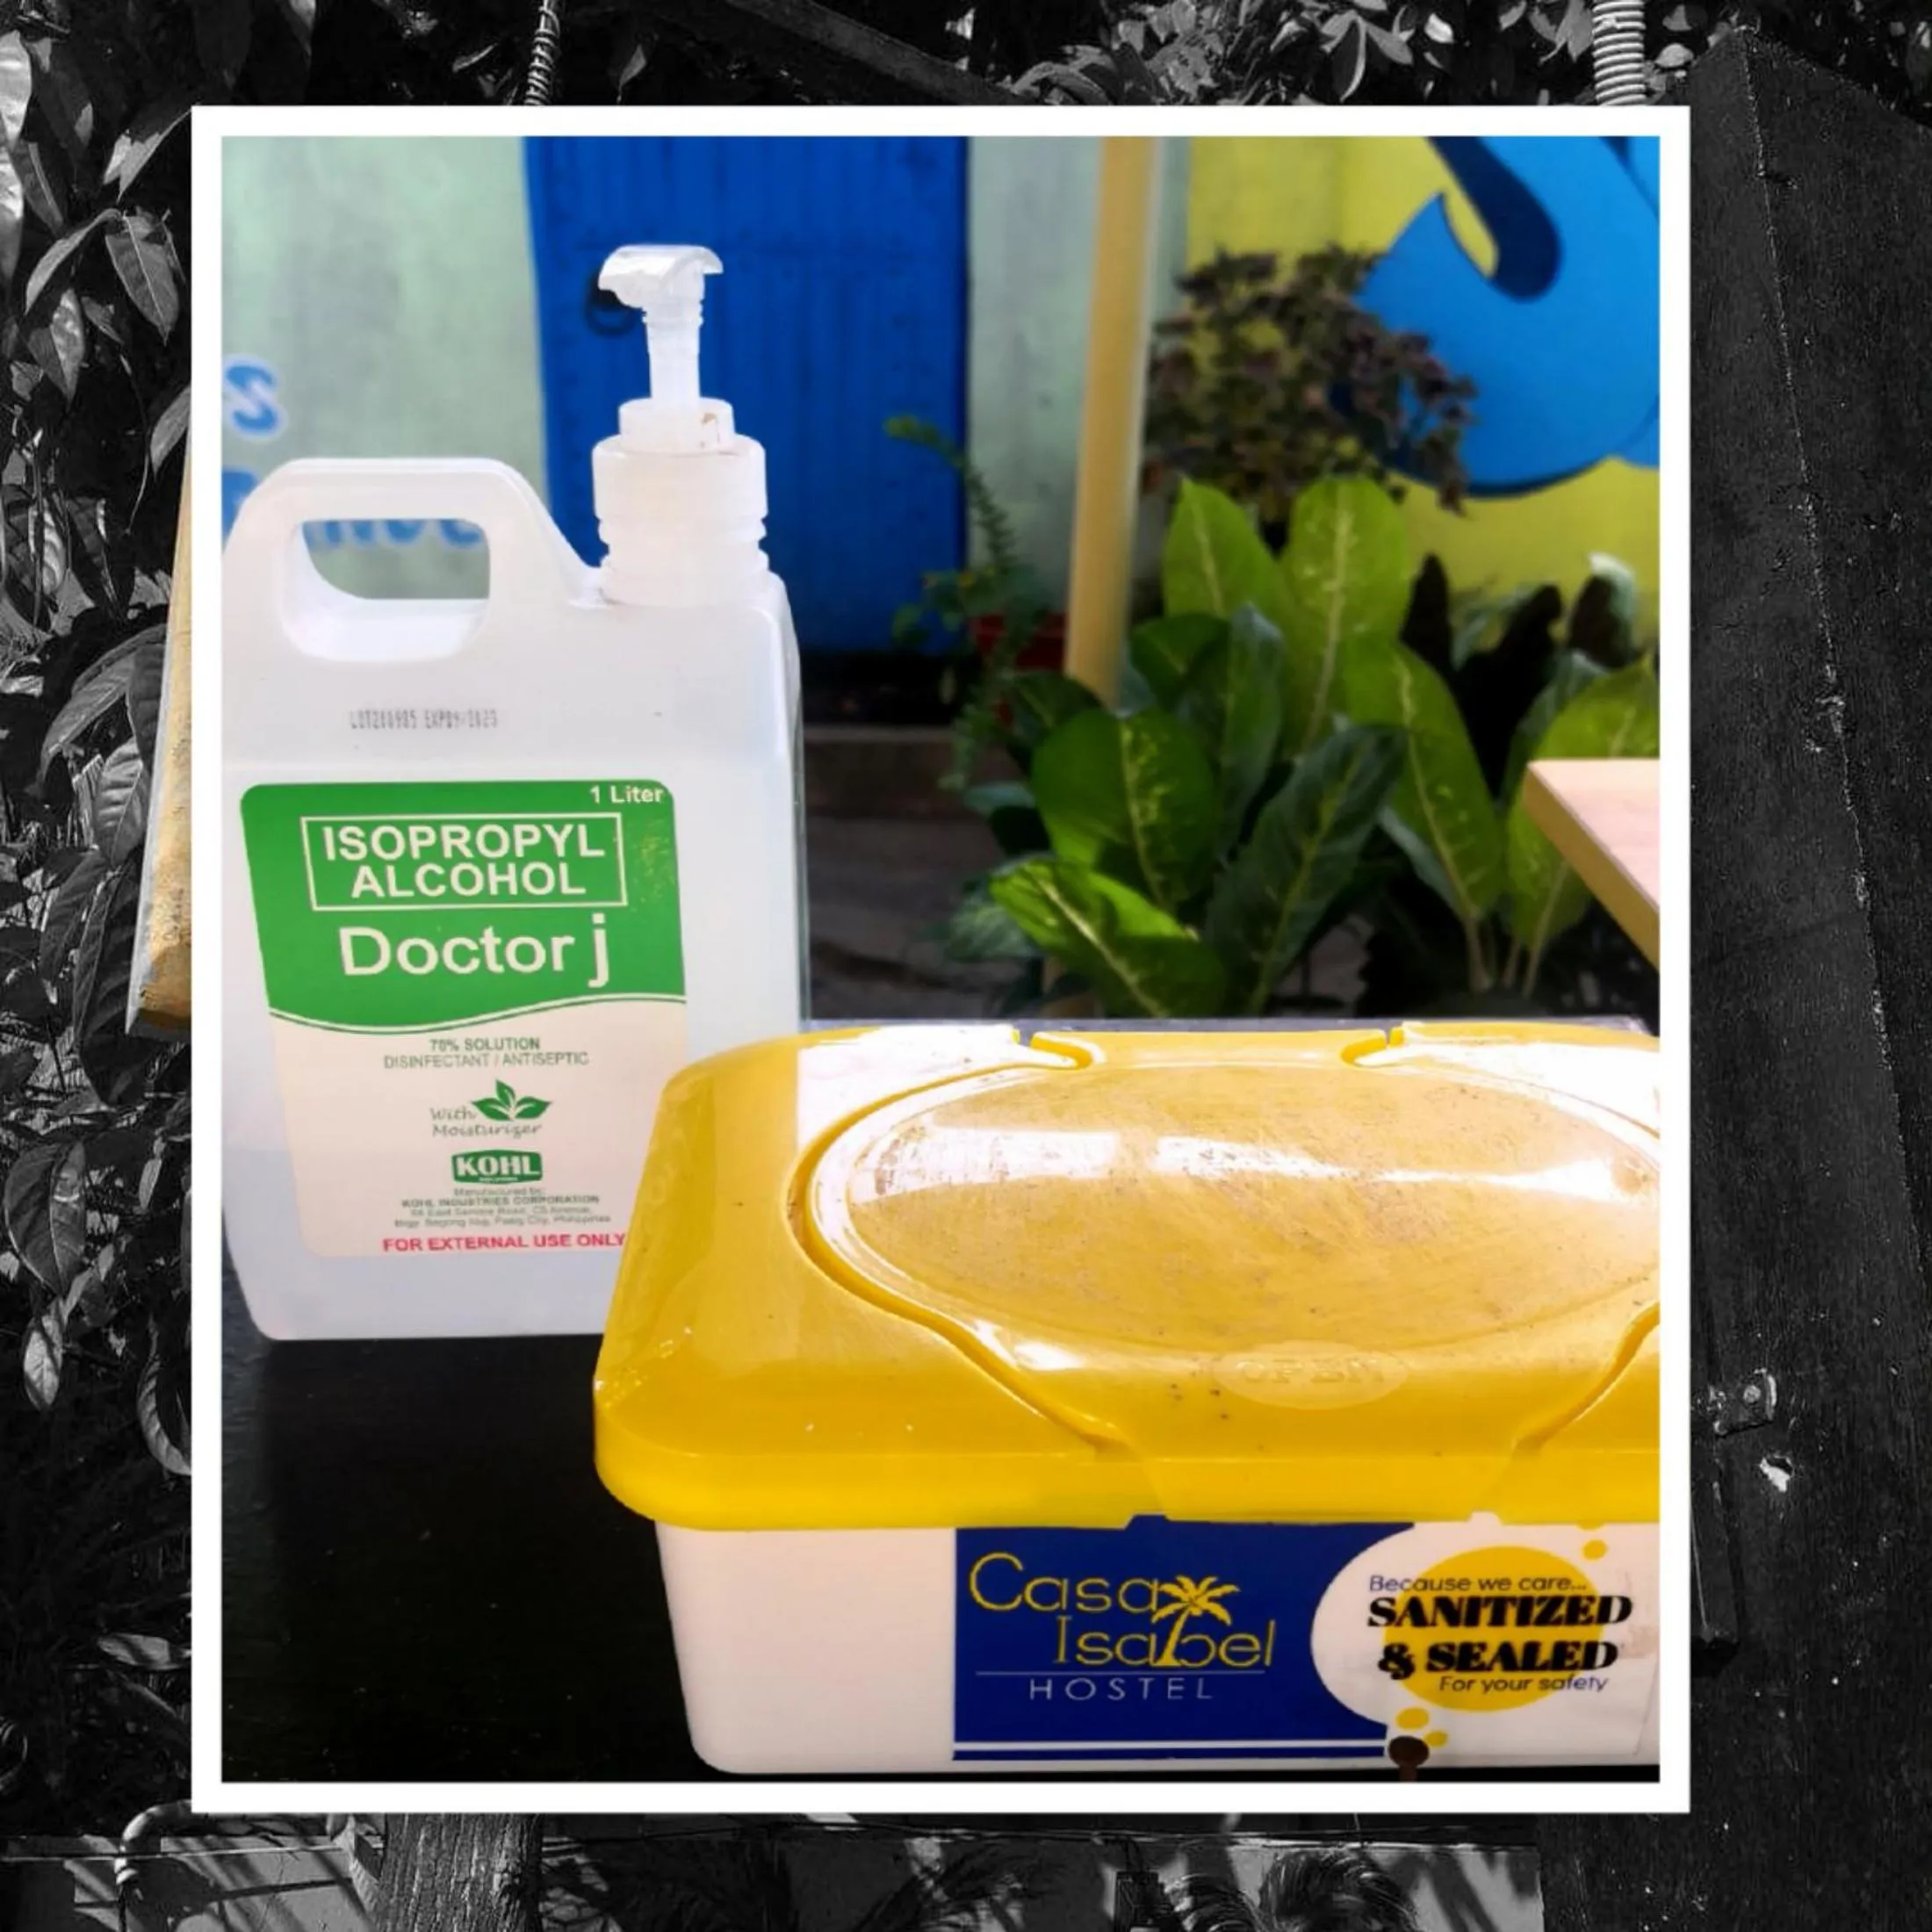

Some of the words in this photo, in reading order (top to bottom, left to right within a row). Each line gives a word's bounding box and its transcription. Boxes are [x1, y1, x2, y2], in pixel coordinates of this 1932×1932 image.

[590, 787, 601, 803] 1
[609, 786, 664, 804] Liter
[321, 824, 605, 861] ISOPROPYL
[350, 861, 586, 899] ALCOHOL
[339, 926, 575, 977] Doctor
[588, 912, 609, 989] j
[465, 1037, 541, 1051] SOLUTION
[384, 1053, 490, 1069] DISINFECTANT
[502, 1051, 589, 1066] ANTISEPTIC
[429, 1107, 475, 1121] With
[455, 1155, 541, 1177] KOHL
[438, 1196, 510, 1208] INDUSTRIES
[514, 1194, 600, 1206] CORPORATION
[383, 1236, 423, 1252] FOR
[428, 1235, 530, 1251] EXTERNAL
[534, 1233, 572, 1249] USE
[576, 1232, 626, 1247] ONLY
[969, 1552, 1159, 1613] Casa
[1369, 1575, 1472, 1592] Because
[1477, 1578, 1512, 1592] we
[1517, 1576, 1587, 1592] care...
[1366, 1595, 1633, 1628] SANITIZED
[1052, 1615, 1277, 1668] Isabel
[1377, 1642, 1417, 1681] &
[1424, 1640, 1619, 1673] SEALED
[1029, 1677, 1213, 1701] HOSTEL
[1438, 1676, 1477, 1692] For
[1480, 1677, 1533, 1695] your
[1538, 1674, 1611, 1692] safety
